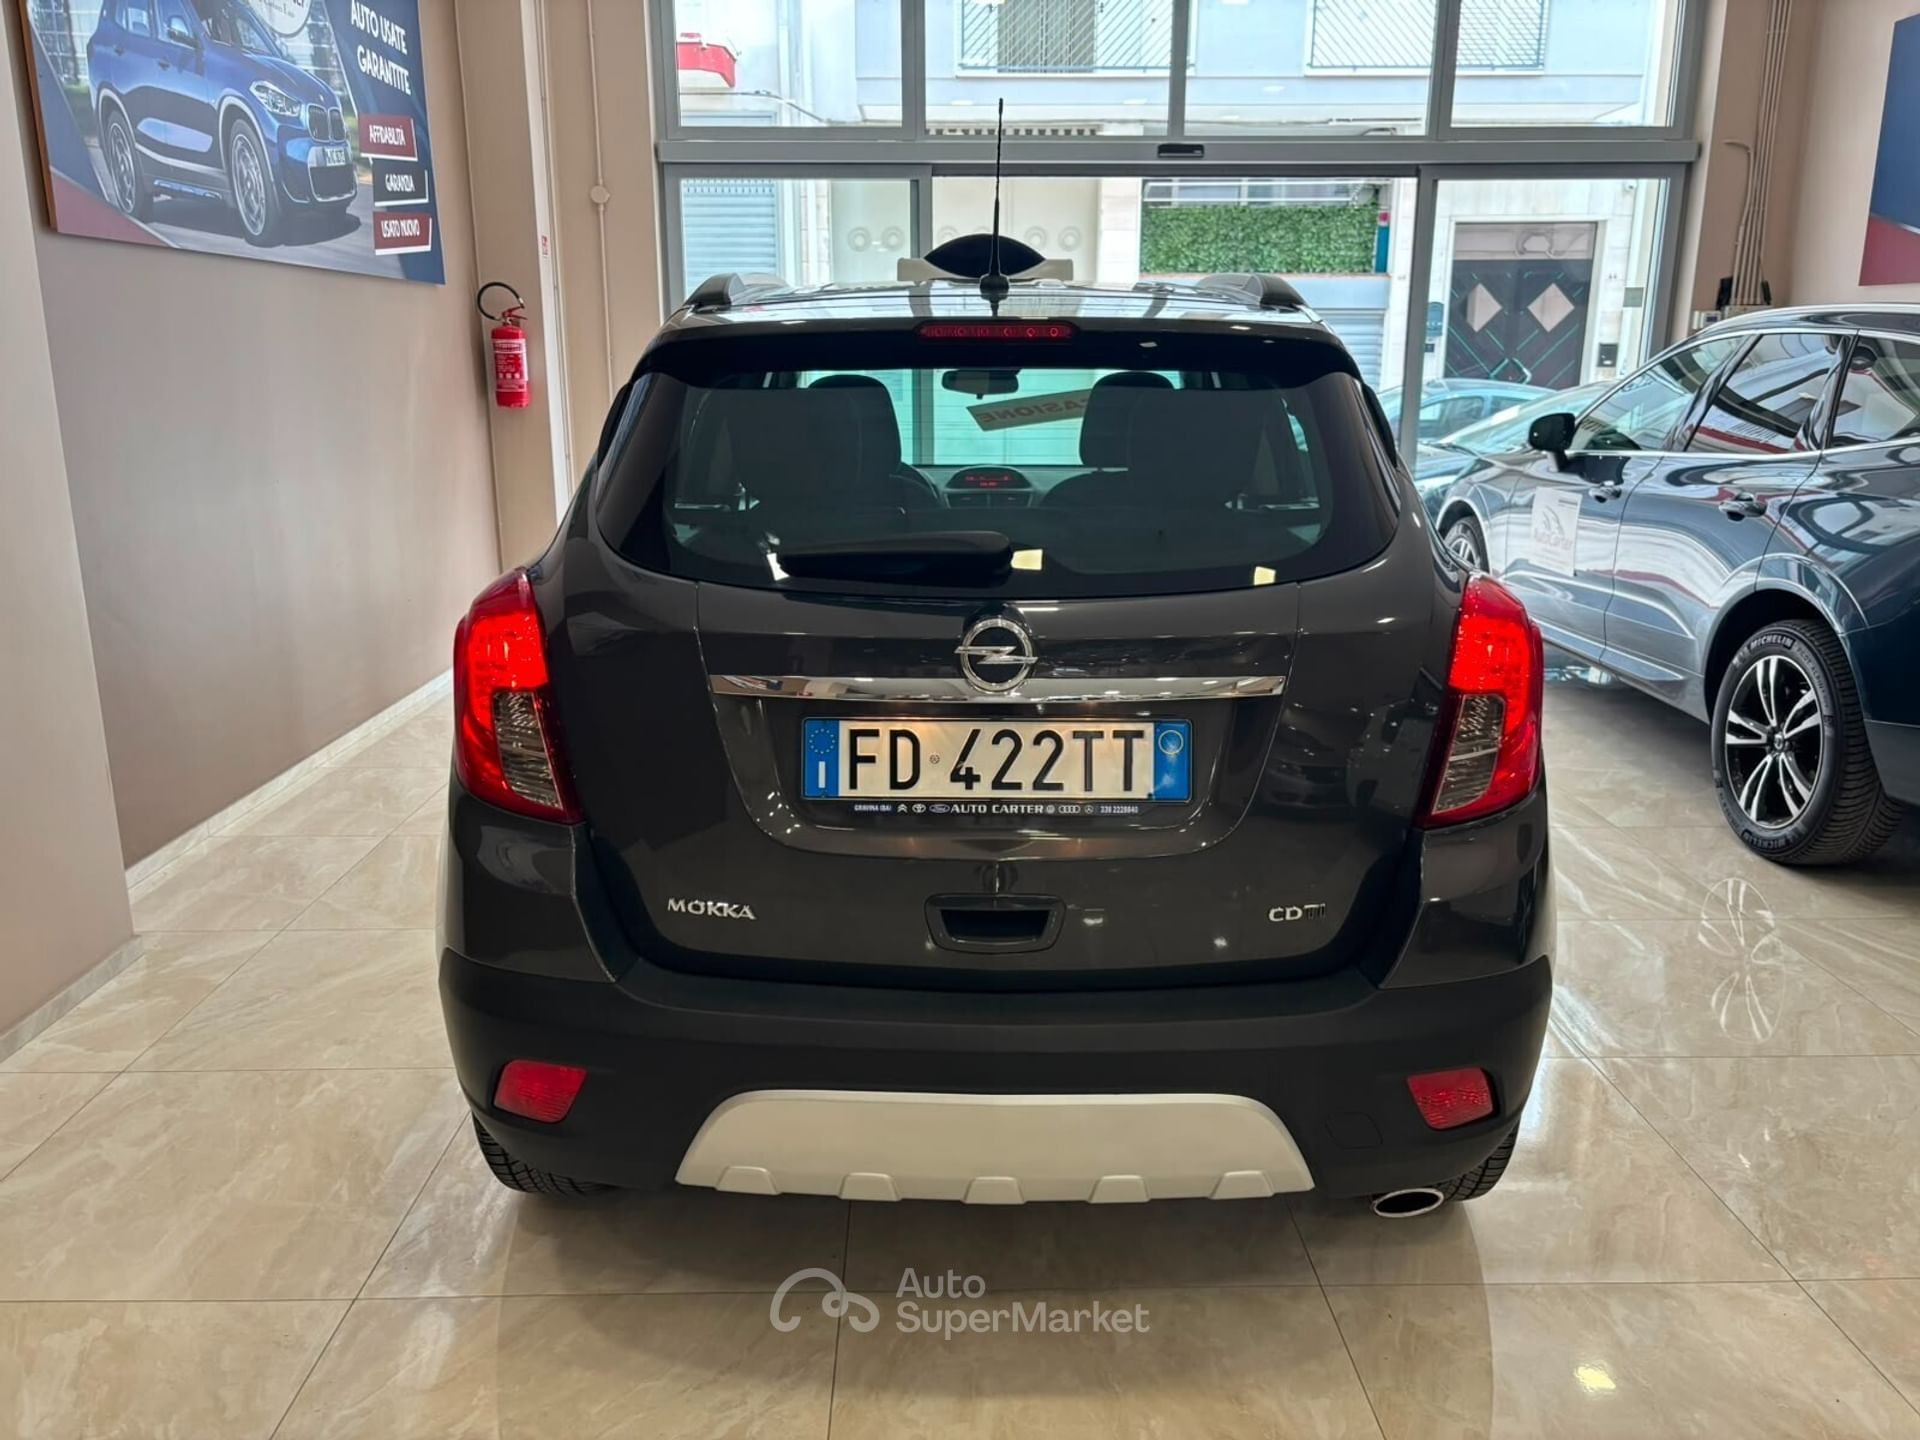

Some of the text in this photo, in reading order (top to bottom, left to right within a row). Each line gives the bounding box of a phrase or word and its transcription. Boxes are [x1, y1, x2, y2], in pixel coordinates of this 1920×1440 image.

[351, 0, 408, 55] AUTO USATE
[357, 44, 411, 96] GARANTITE
[385, 173, 415, 192] GARANZIA
[381, 218, 420, 238] USATO NUOVO
[1750, 634, 1794, 649] MICHELIN
[848, 728, 1144, 791] FD 422TT
[951, 804, 1044, 814] AUTO CARTER
[667, 898, 757, 920] MOKKA
